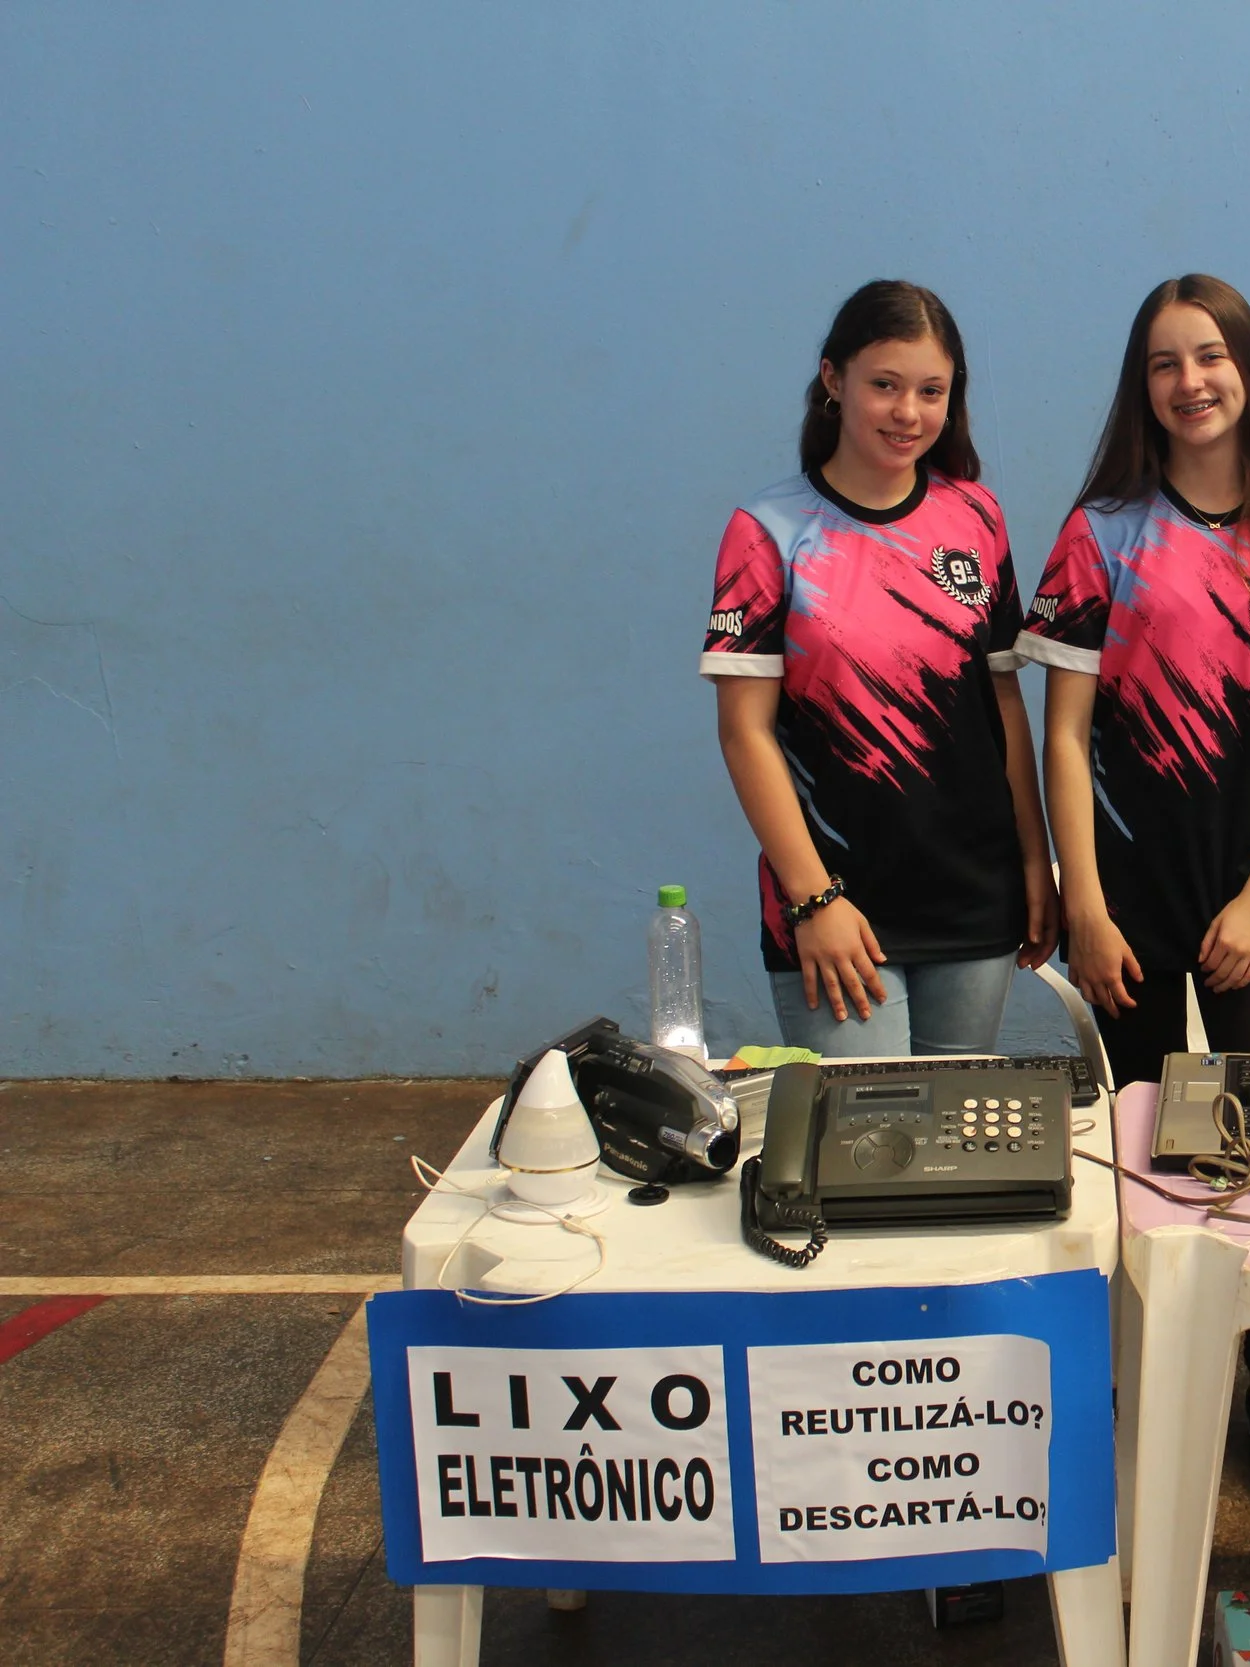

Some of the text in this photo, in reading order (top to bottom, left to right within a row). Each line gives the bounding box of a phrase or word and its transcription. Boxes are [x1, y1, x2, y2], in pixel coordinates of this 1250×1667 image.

[708, 609, 743, 637] NDOS
[603, 1141, 648, 1172] Panasonic
[923, 1165, 958, 1173] SHARP
[852, 1356, 961, 1387] COMO
[433, 1371, 711, 1431] LIXO
[781, 1396, 1045, 1436] REUTILIZÁ-LO?
[437, 1442, 715, 1522] ELETRÔNICO
[867, 1452, 980, 1482] COMO
